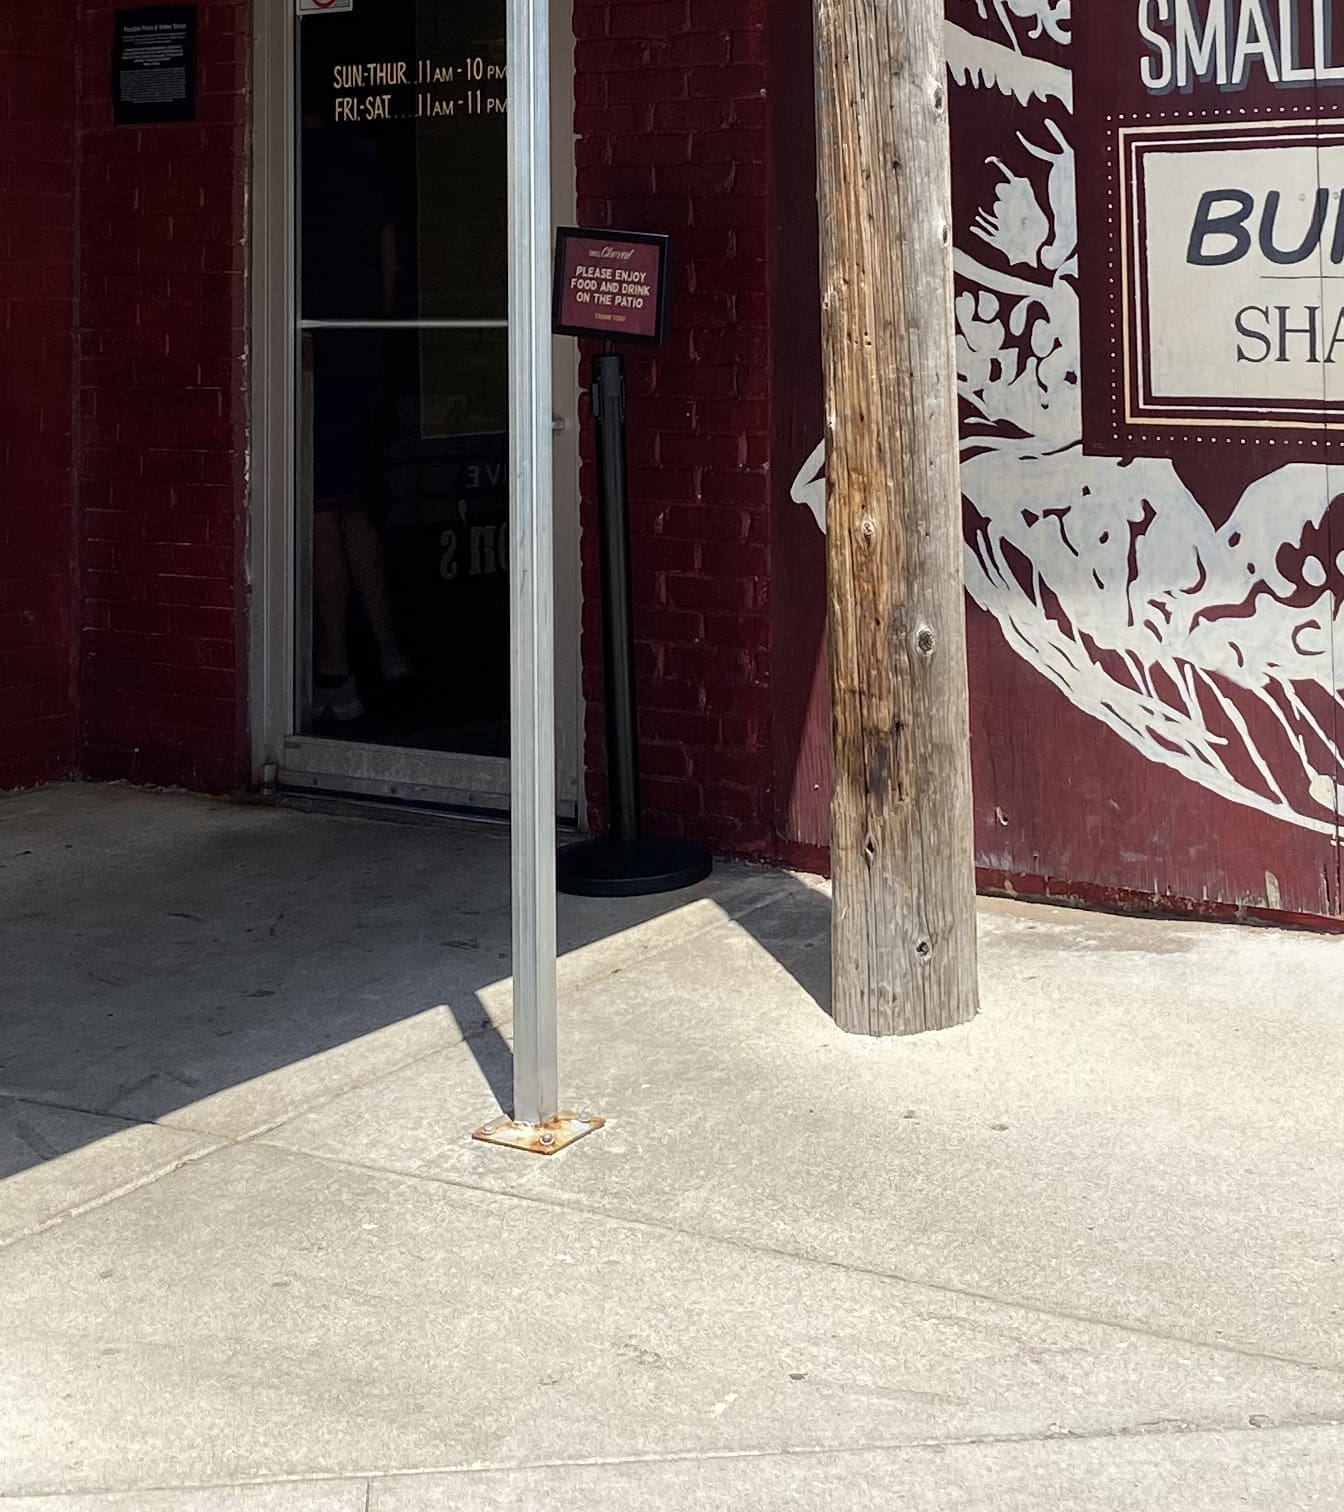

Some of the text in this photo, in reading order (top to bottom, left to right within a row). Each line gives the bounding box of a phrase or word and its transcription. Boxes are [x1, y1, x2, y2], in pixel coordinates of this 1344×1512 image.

[466, 57, 483, 81] 10
[467, 90, 481, 114] 11
[576, 266, 646, 283] PLEASE ENJOY
[571, 278, 651, 296] FOOD AND DRINK
[576, 292, 644, 308] ON THE PATIO
